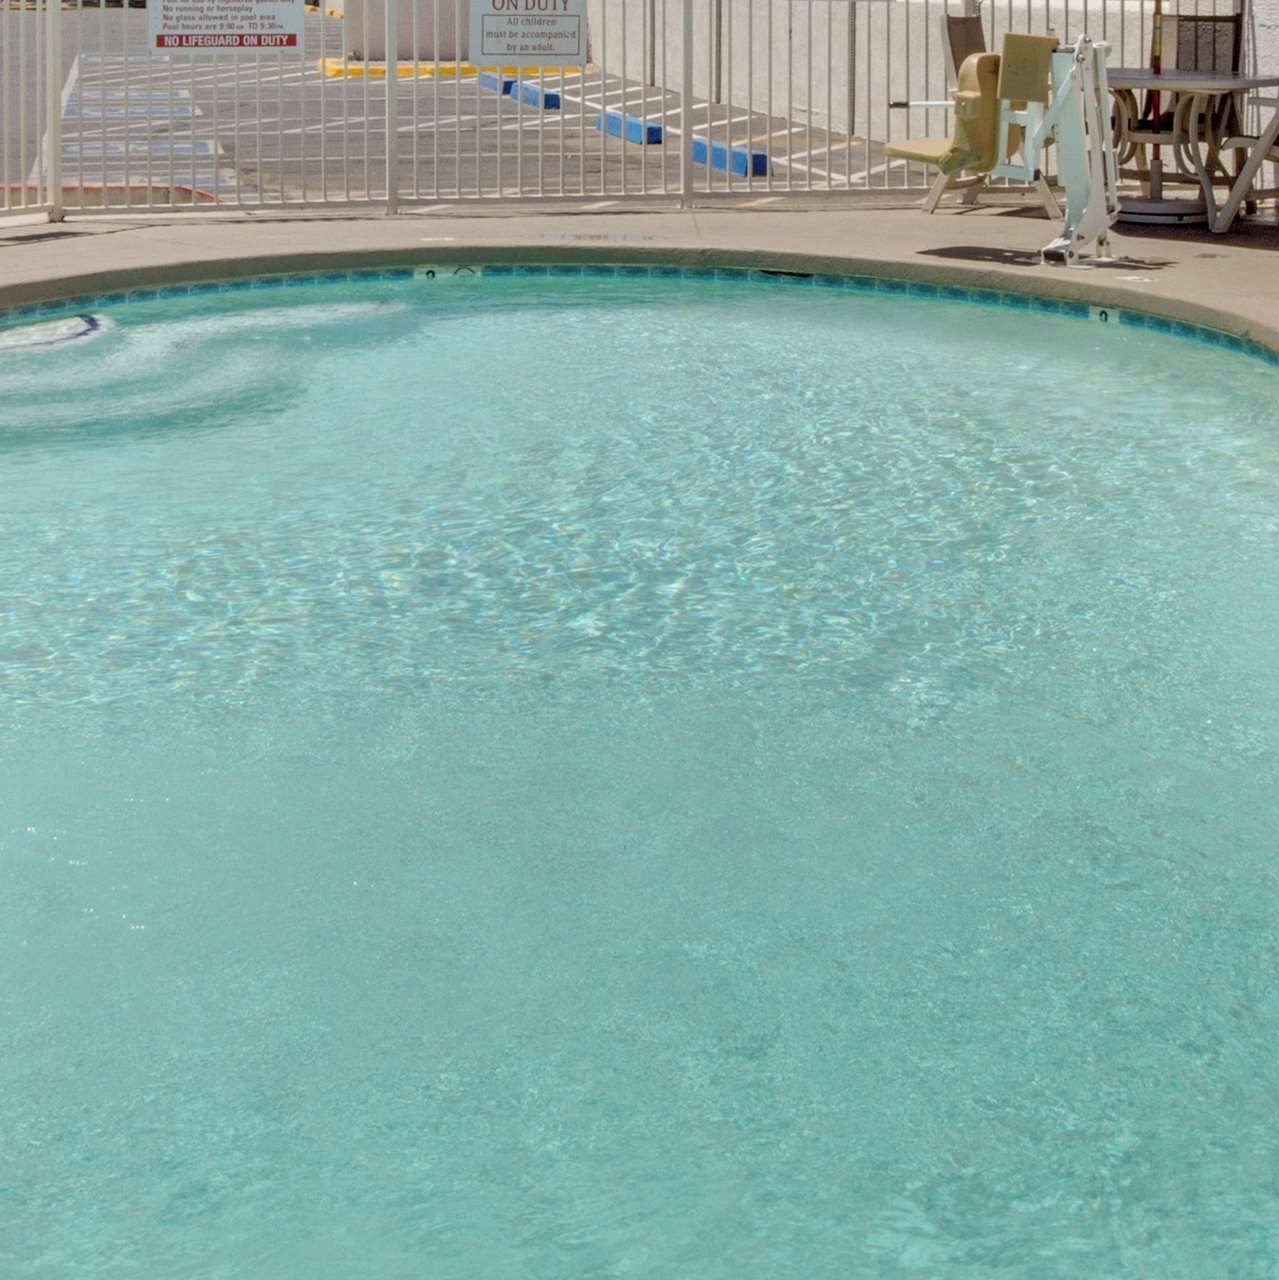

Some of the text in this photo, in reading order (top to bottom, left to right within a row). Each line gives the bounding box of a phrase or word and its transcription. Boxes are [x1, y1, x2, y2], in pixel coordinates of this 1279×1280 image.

[163, 4, 173, 12] No
[175, 5, 204, 13] running
[216, 4, 253, 13] horseplay
[163, 13, 173, 21] No
[176, 13, 196, 22] glass
[198, 13, 229, 21] allowed
[230, 13, 238, 21] in
[239, 13, 257, 22] pool
[506, 17, 557, 26] All children
[181, 22, 202, 31] hours
[485, 30, 577, 40] must be accompanied
[164, 35, 289, 47] NO LIFEGUARD ON DUTY
[506, 43, 516, 52] by
